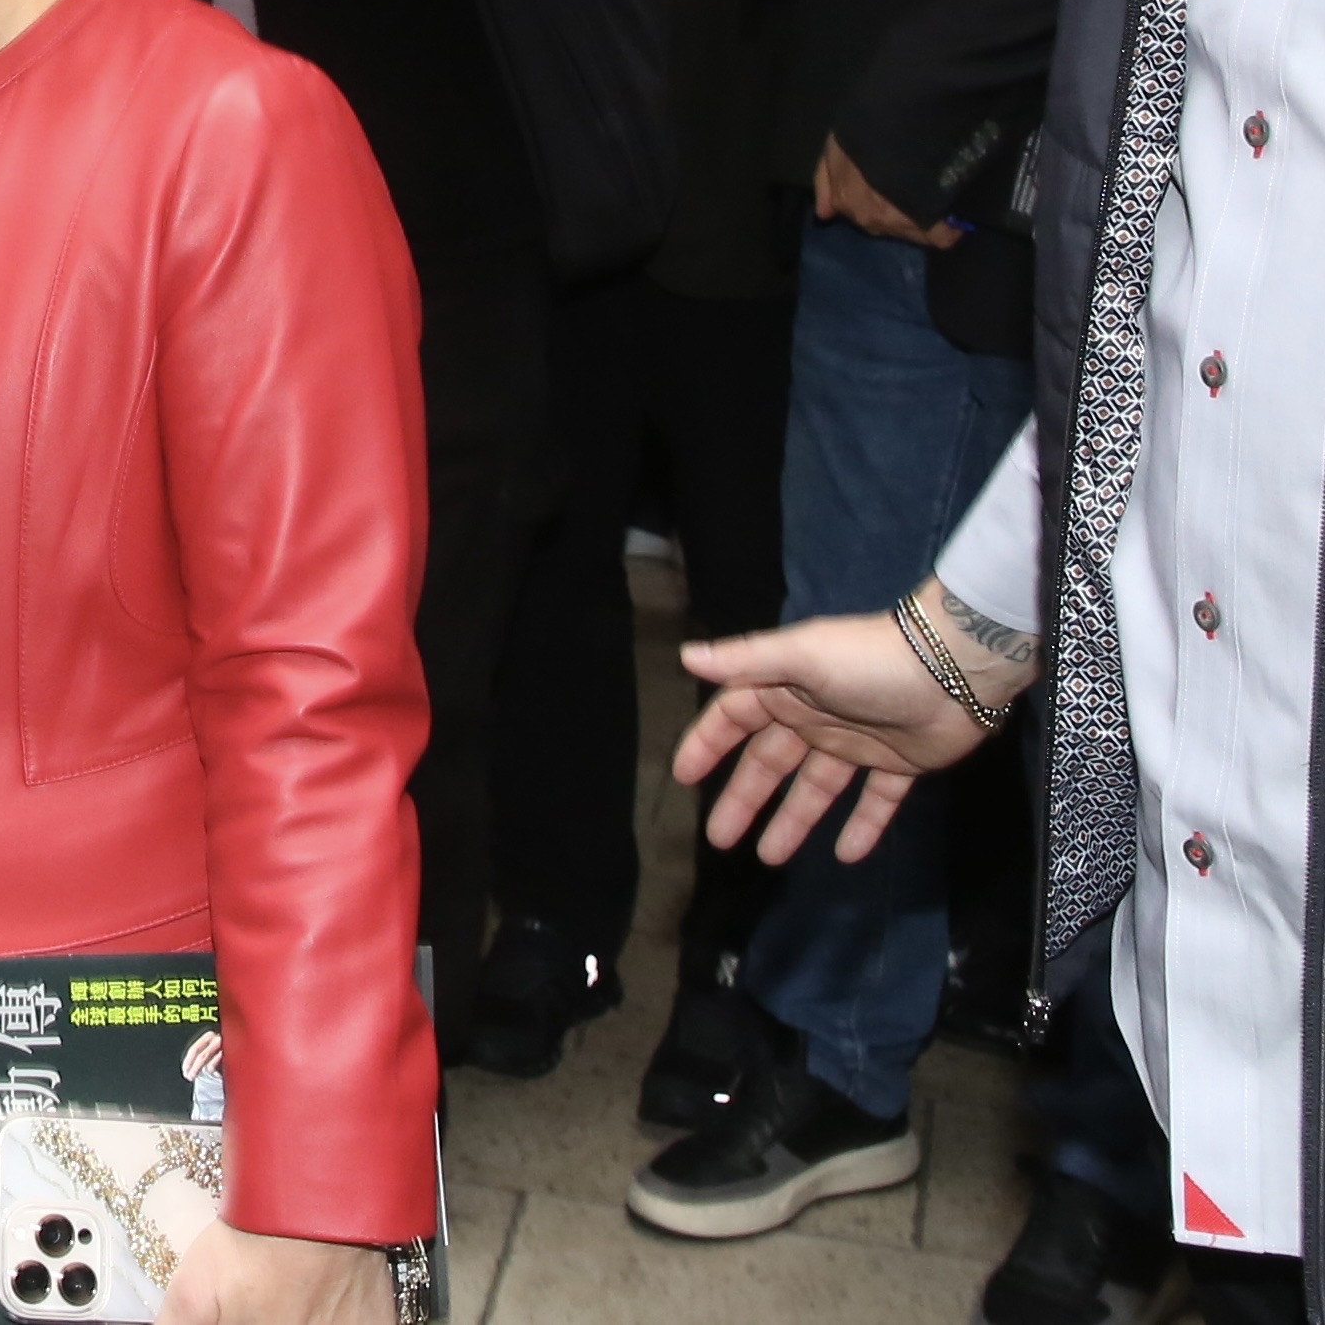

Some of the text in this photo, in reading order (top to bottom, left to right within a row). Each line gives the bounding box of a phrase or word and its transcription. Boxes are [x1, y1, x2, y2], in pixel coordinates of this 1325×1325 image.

[70, 1004, 218, 1027] 全球最搶手的晶片
